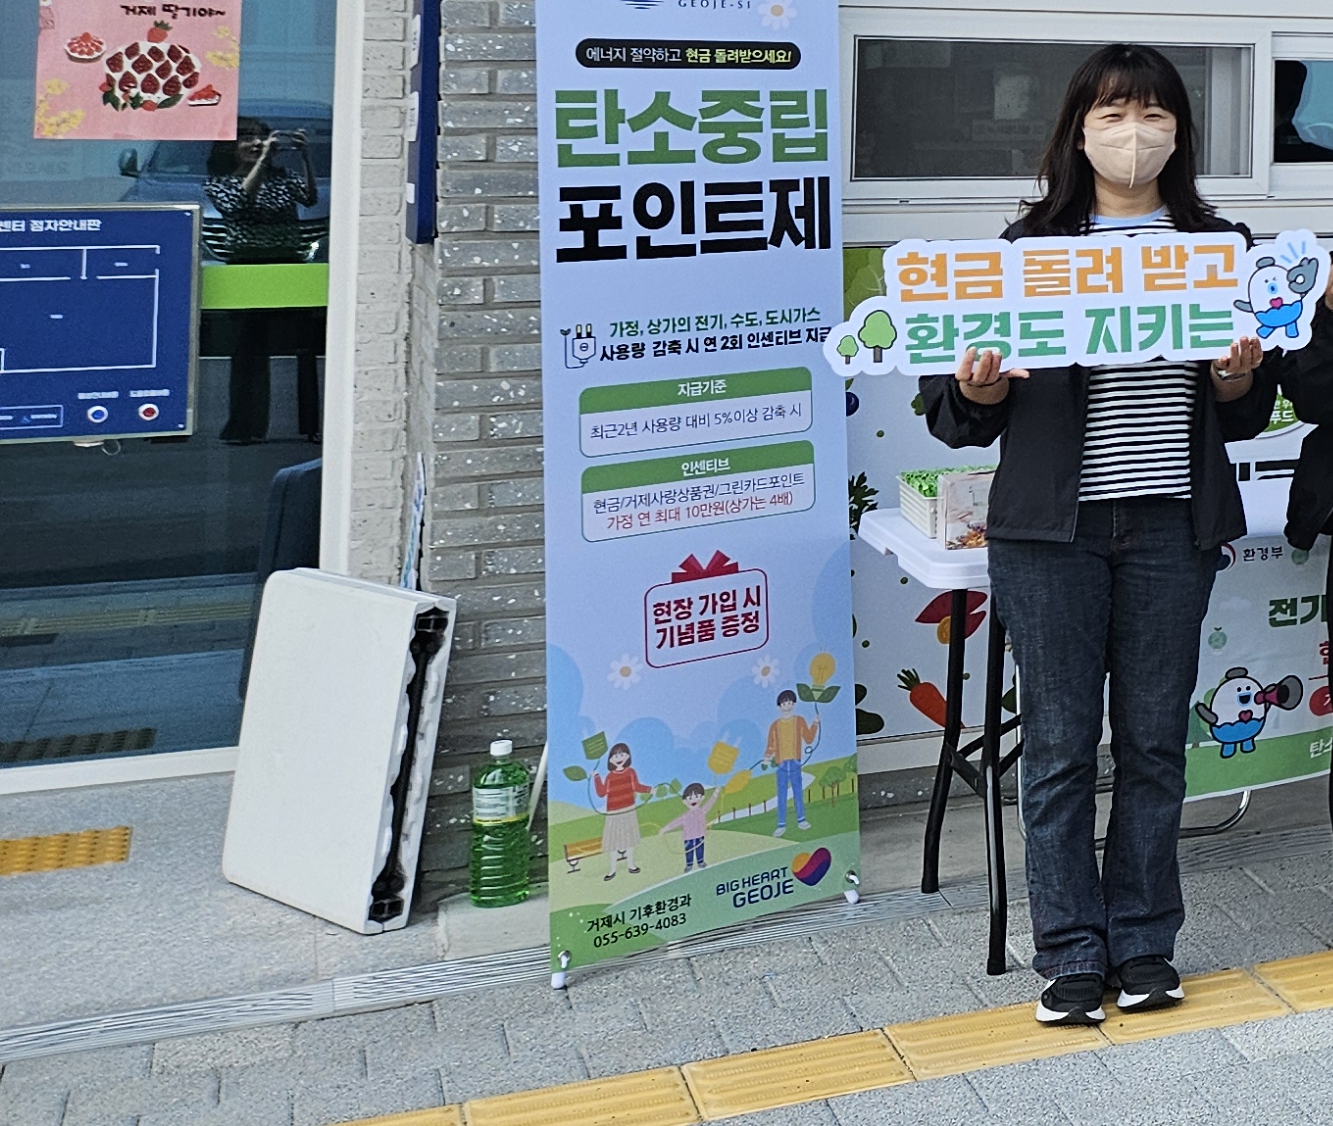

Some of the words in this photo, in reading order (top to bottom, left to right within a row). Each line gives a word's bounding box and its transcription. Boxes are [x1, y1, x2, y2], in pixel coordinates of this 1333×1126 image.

[120, 5, 156, 16] 거제
[586, 47, 626, 62] 에너지
[630, 47, 682, 64] 절약하고
[685, 47, 711, 63] 현금
[713, 47, 792, 65] 돌려받으세요!
[554, 89, 828, 167] 탄소중립
[30, 219, 102, 232] 점자안내판
[556, 176, 832, 263] 포인트제
[897, 251, 1002, 302] 현금
[1023, 247, 1123, 297] 돌려
[1141, 244, 1238, 291] 받고
[610, 321, 643, 337] 가정,
[646, 316, 686, 334] 상가의
[694, 314, 727, 331] 전기,
[730, 311, 762, 327] 수도,
[765, 307, 821, 325] 도시가스
[905, 310, 1067, 364] 환경도
[1085, 303, 1233, 355] 지키는
[600, 342, 646, 362] 사용량
[653, 339, 681, 357] 감축
[685, 338, 699, 354] 시
[703, 336, 718, 352] 연
[720, 334, 743, 351] 2회
[747, 329, 802, 349] 인센티브
[677, 379, 727, 397] 지급기준
[590, 423, 638, 439] 최근2년
[642, 419, 681, 434] 사용량
[685, 413, 710, 429] 대비
[714, 407, 758, 425] 5%이상
[762, 405, 786, 420] 감축
[790, 403, 802, 418] 시
[681, 458, 730, 476] 인센티브
[607, 514, 633, 530] 가정
[637, 511, 651, 527] 연
[655, 508, 680, 524] 최대
[685, 496, 766, 519] 10만원(상가는
[770, 492, 793, 508] 4배)
[1243, 546, 1283, 562] 환경부
[653, 596, 693, 624] 현장
[699, 590, 737, 615] 가입
[743, 585, 761, 608] 시
[656, 622, 715, 649] 기념품
[721, 611, 760, 635] 증정
[716, 881, 739, 896] BIG
[742, 867, 788, 889] HEART
[733, 879, 794, 908] GEOJE
[586, 911, 626, 932] 거제시
[629, 894, 691, 921] 기후환경과
[593, 913, 687, 948] 055-639-4083
